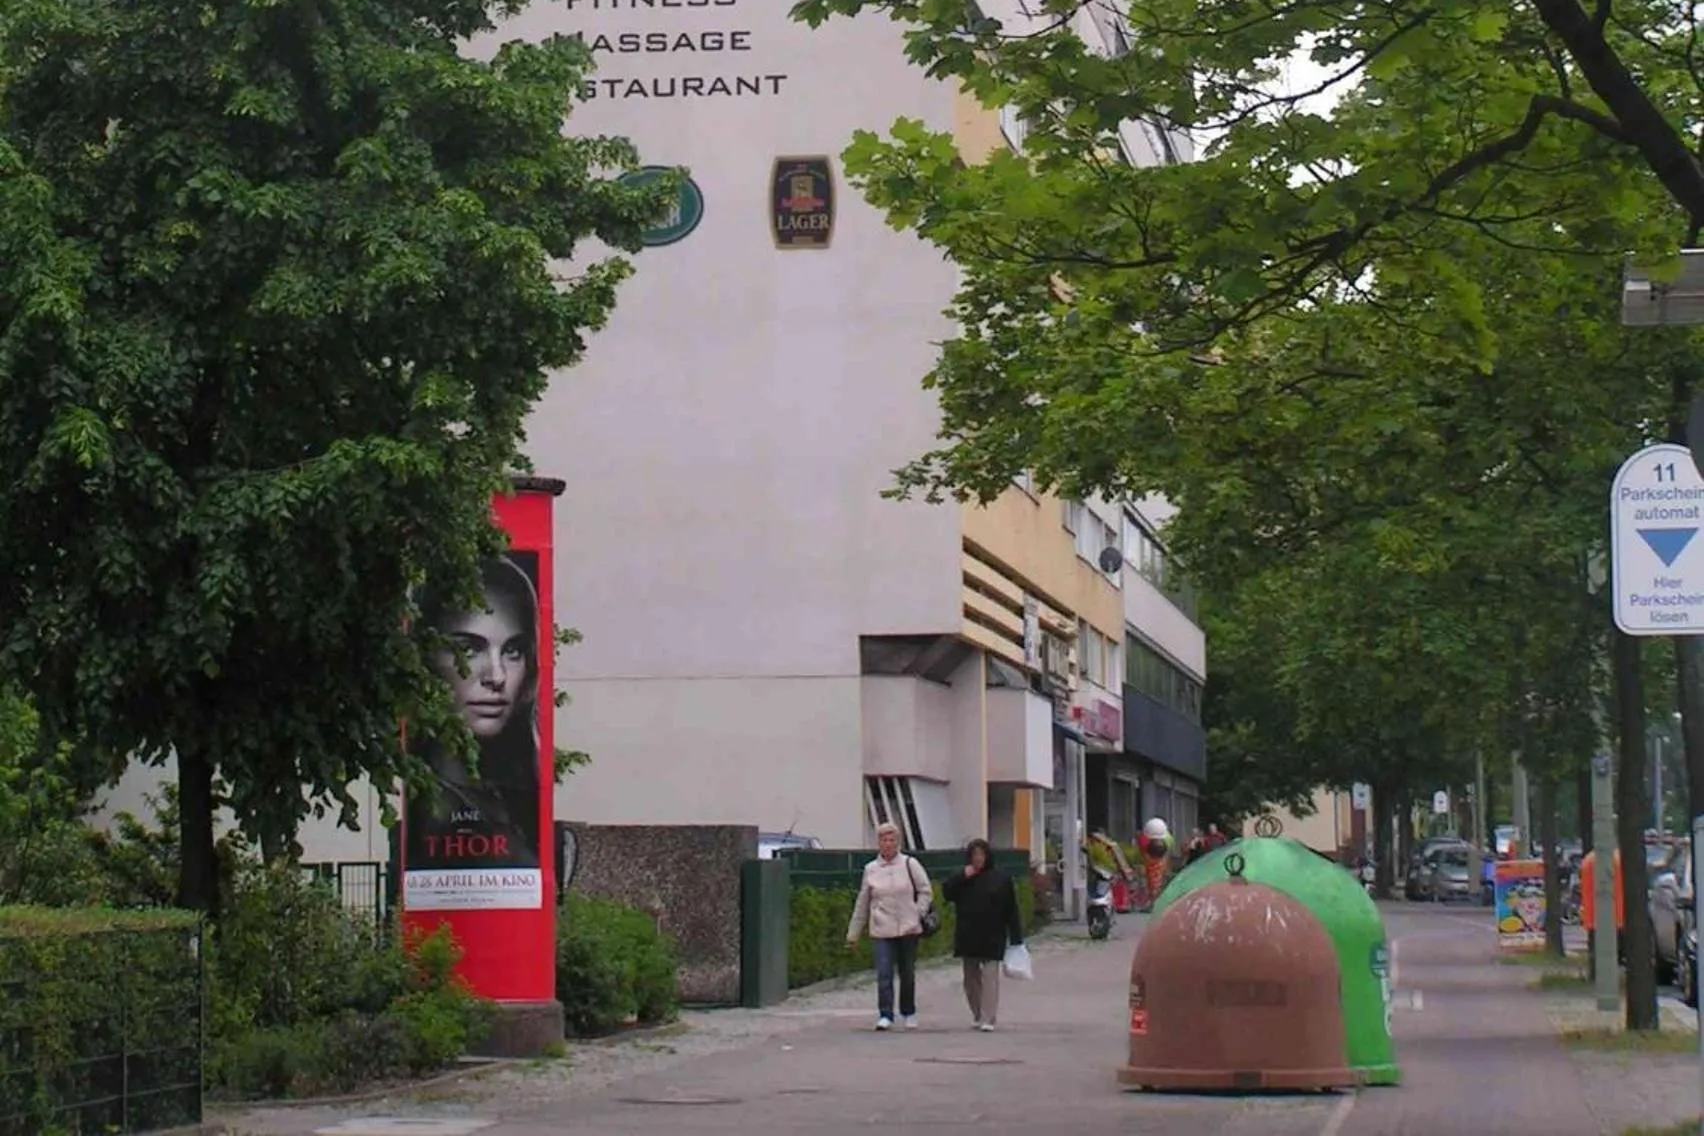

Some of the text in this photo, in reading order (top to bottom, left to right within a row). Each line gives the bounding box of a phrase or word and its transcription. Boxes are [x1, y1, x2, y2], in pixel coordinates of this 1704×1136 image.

[554, 30, 752, 54] ASSAGE
[778, 213, 830, 231] LAGER
[1653, 463, 1676, 483] 11
[1635, 506, 1700, 521] automat
[1653, 577, 1683, 589] Hier
[1650, 611, 1689, 623] lösen
[425, 834, 510, 858] THOR
[502, 875, 536, 886] KINO
